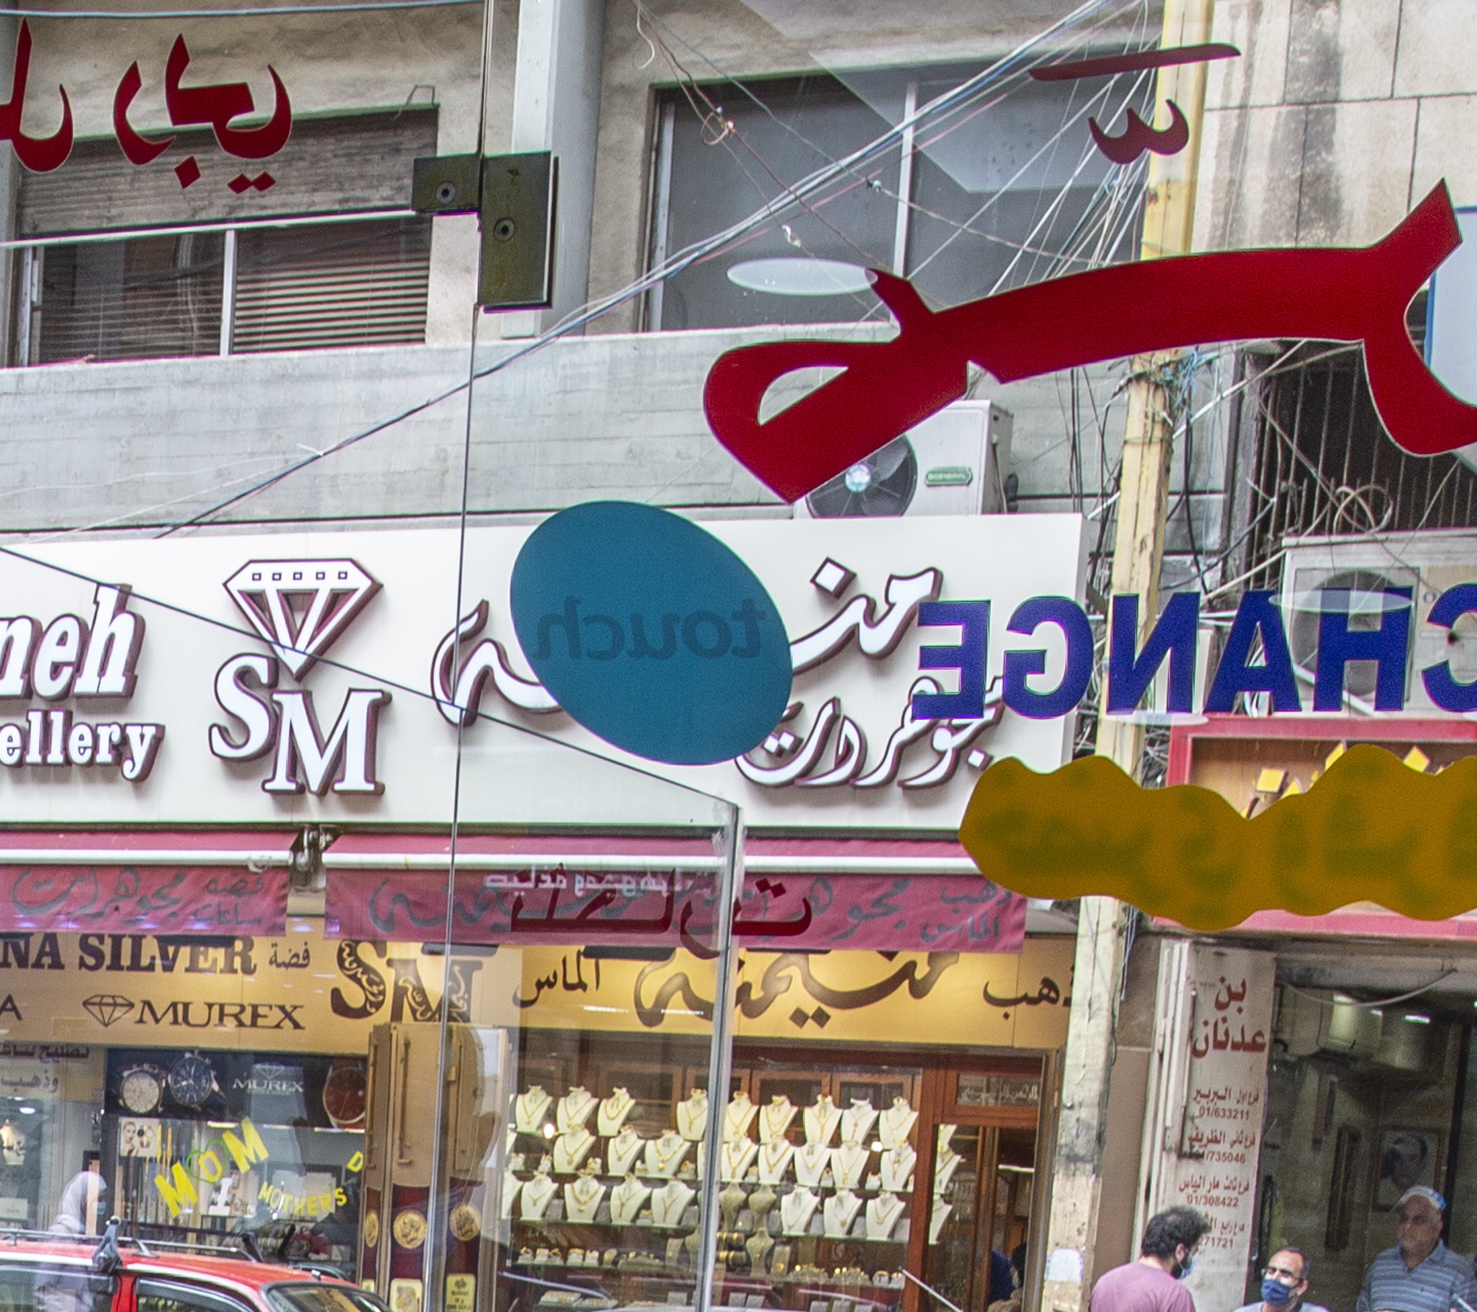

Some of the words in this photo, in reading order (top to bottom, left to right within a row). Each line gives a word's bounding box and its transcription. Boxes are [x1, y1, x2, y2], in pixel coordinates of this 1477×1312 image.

[78, 934, 257, 976] SILVER
[269, 939, 311, 970] فضة
[512, 948, 601, 1008] الماس
[1213, 974, 1248, 1013] بن
[136, 998, 306, 1031] MUREX
[1191, 1016, 1267, 1060] عدنان
[232, 1077, 304, 1096] MUREX
[1198, 1105, 1250, 1121] 01/633211
[154, 1116, 269, 1219] MOM
[1204, 1150, 1246, 1165] 1/735046
[1186, 1193, 1240, 1208] 01/308422
